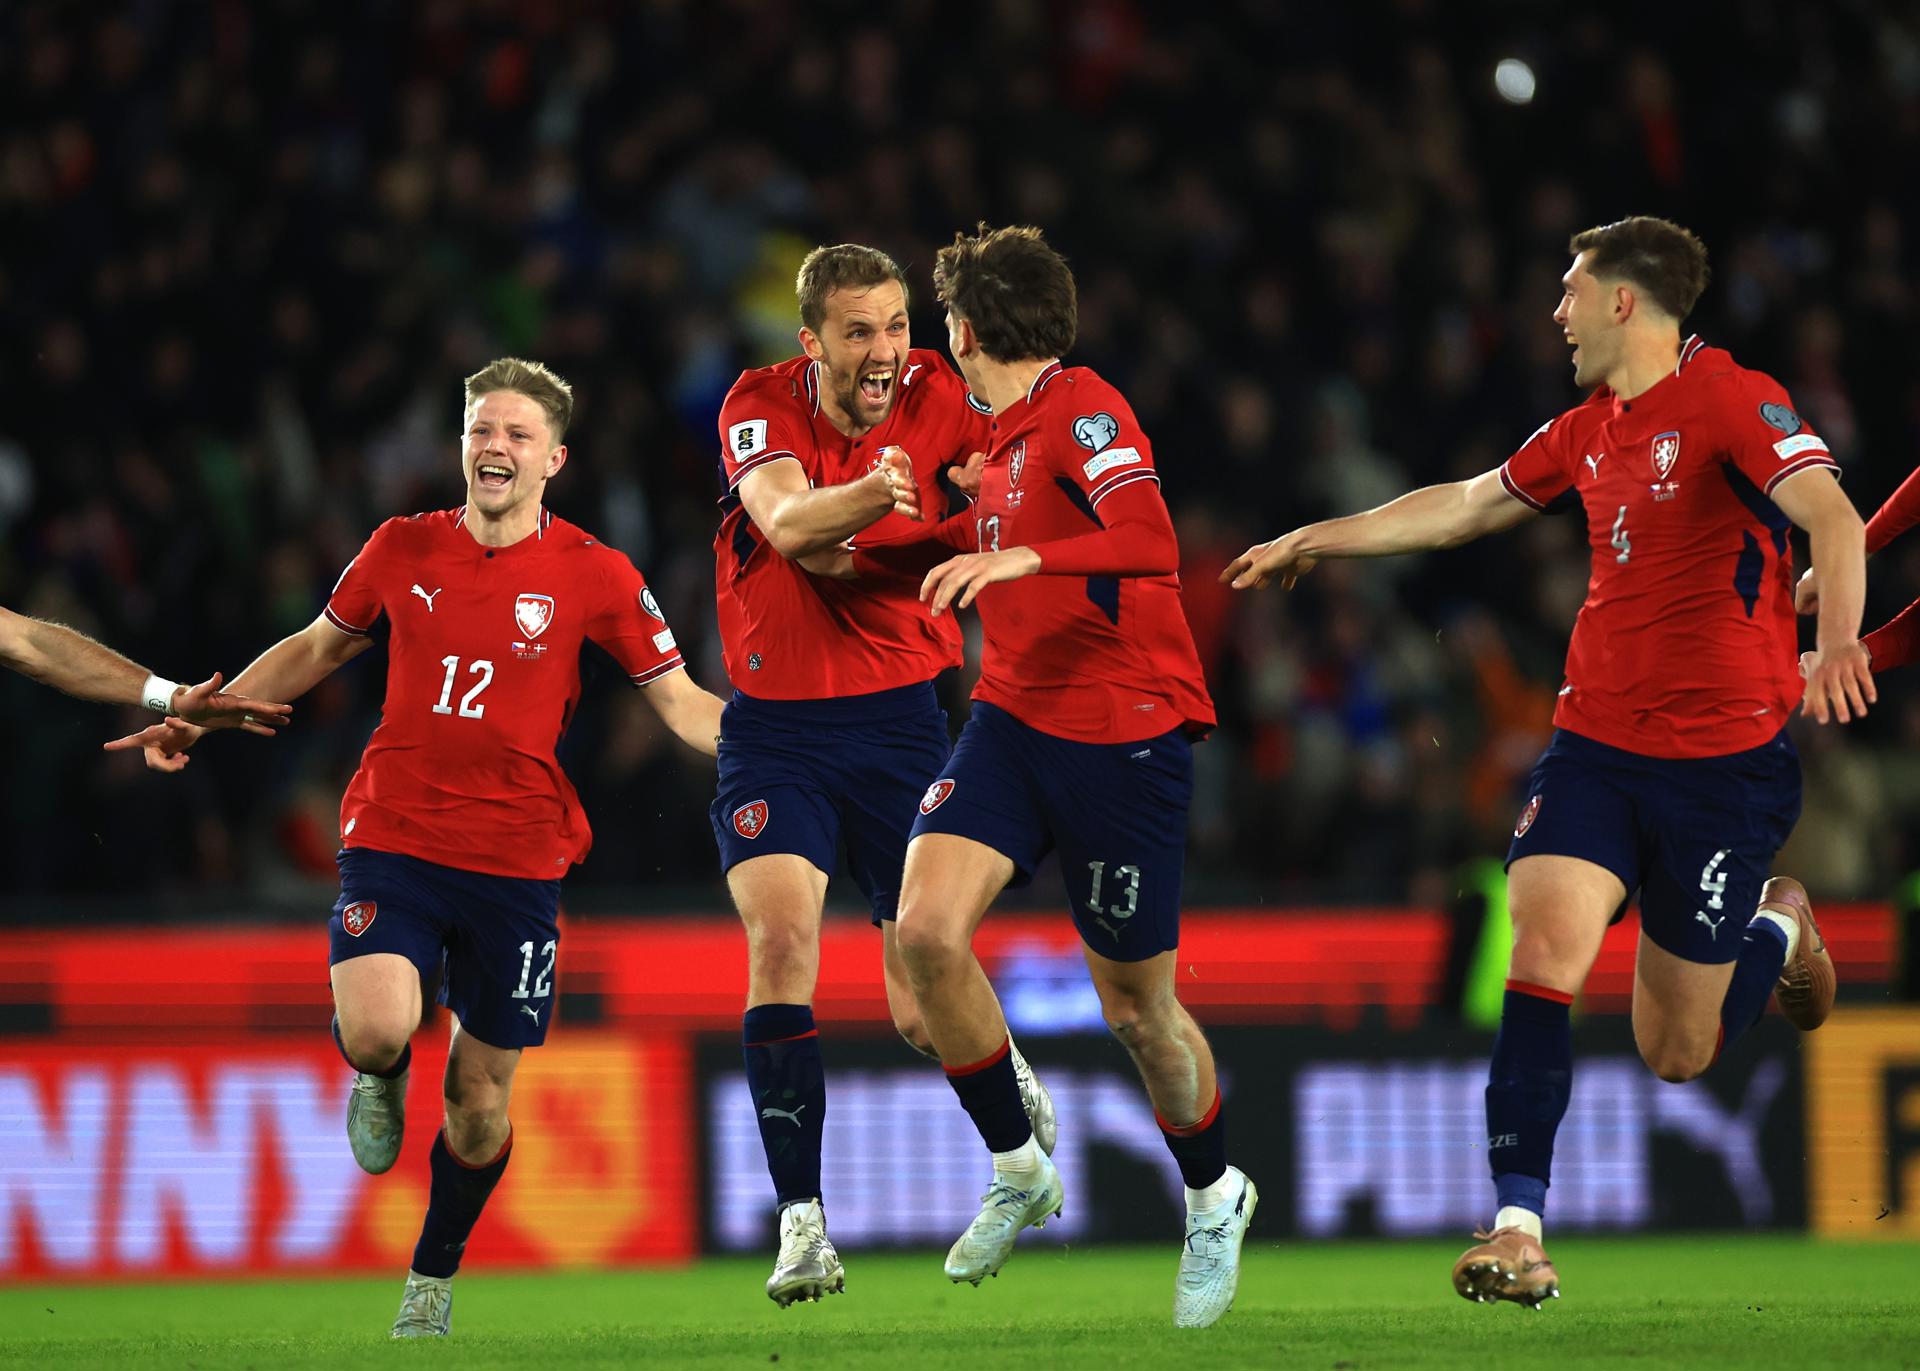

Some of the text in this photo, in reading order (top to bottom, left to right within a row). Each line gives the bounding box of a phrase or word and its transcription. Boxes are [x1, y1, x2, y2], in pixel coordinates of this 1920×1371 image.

[1611, 505, 1631, 564] 4
[432, 655, 494, 719] 12
[1085, 861, 1139, 918] 13
[1700, 849, 1731, 909] 4
[512, 940, 556, 998] 12
